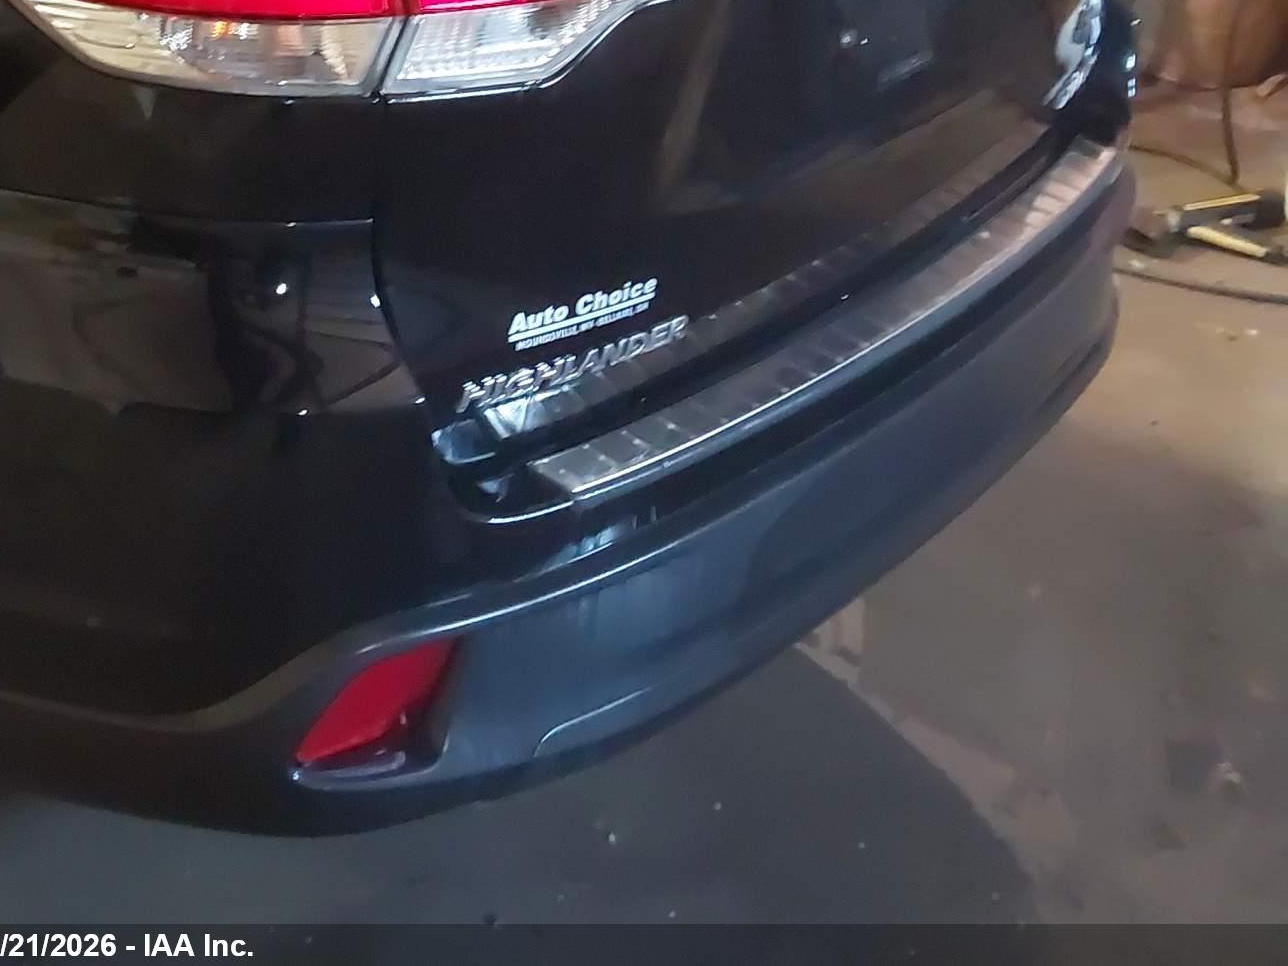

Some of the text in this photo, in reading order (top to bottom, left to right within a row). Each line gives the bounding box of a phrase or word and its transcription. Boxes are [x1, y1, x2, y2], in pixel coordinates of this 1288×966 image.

[508, 279, 658, 335] Auto Choice
[455, 315, 689, 413] HIGHLANDER
